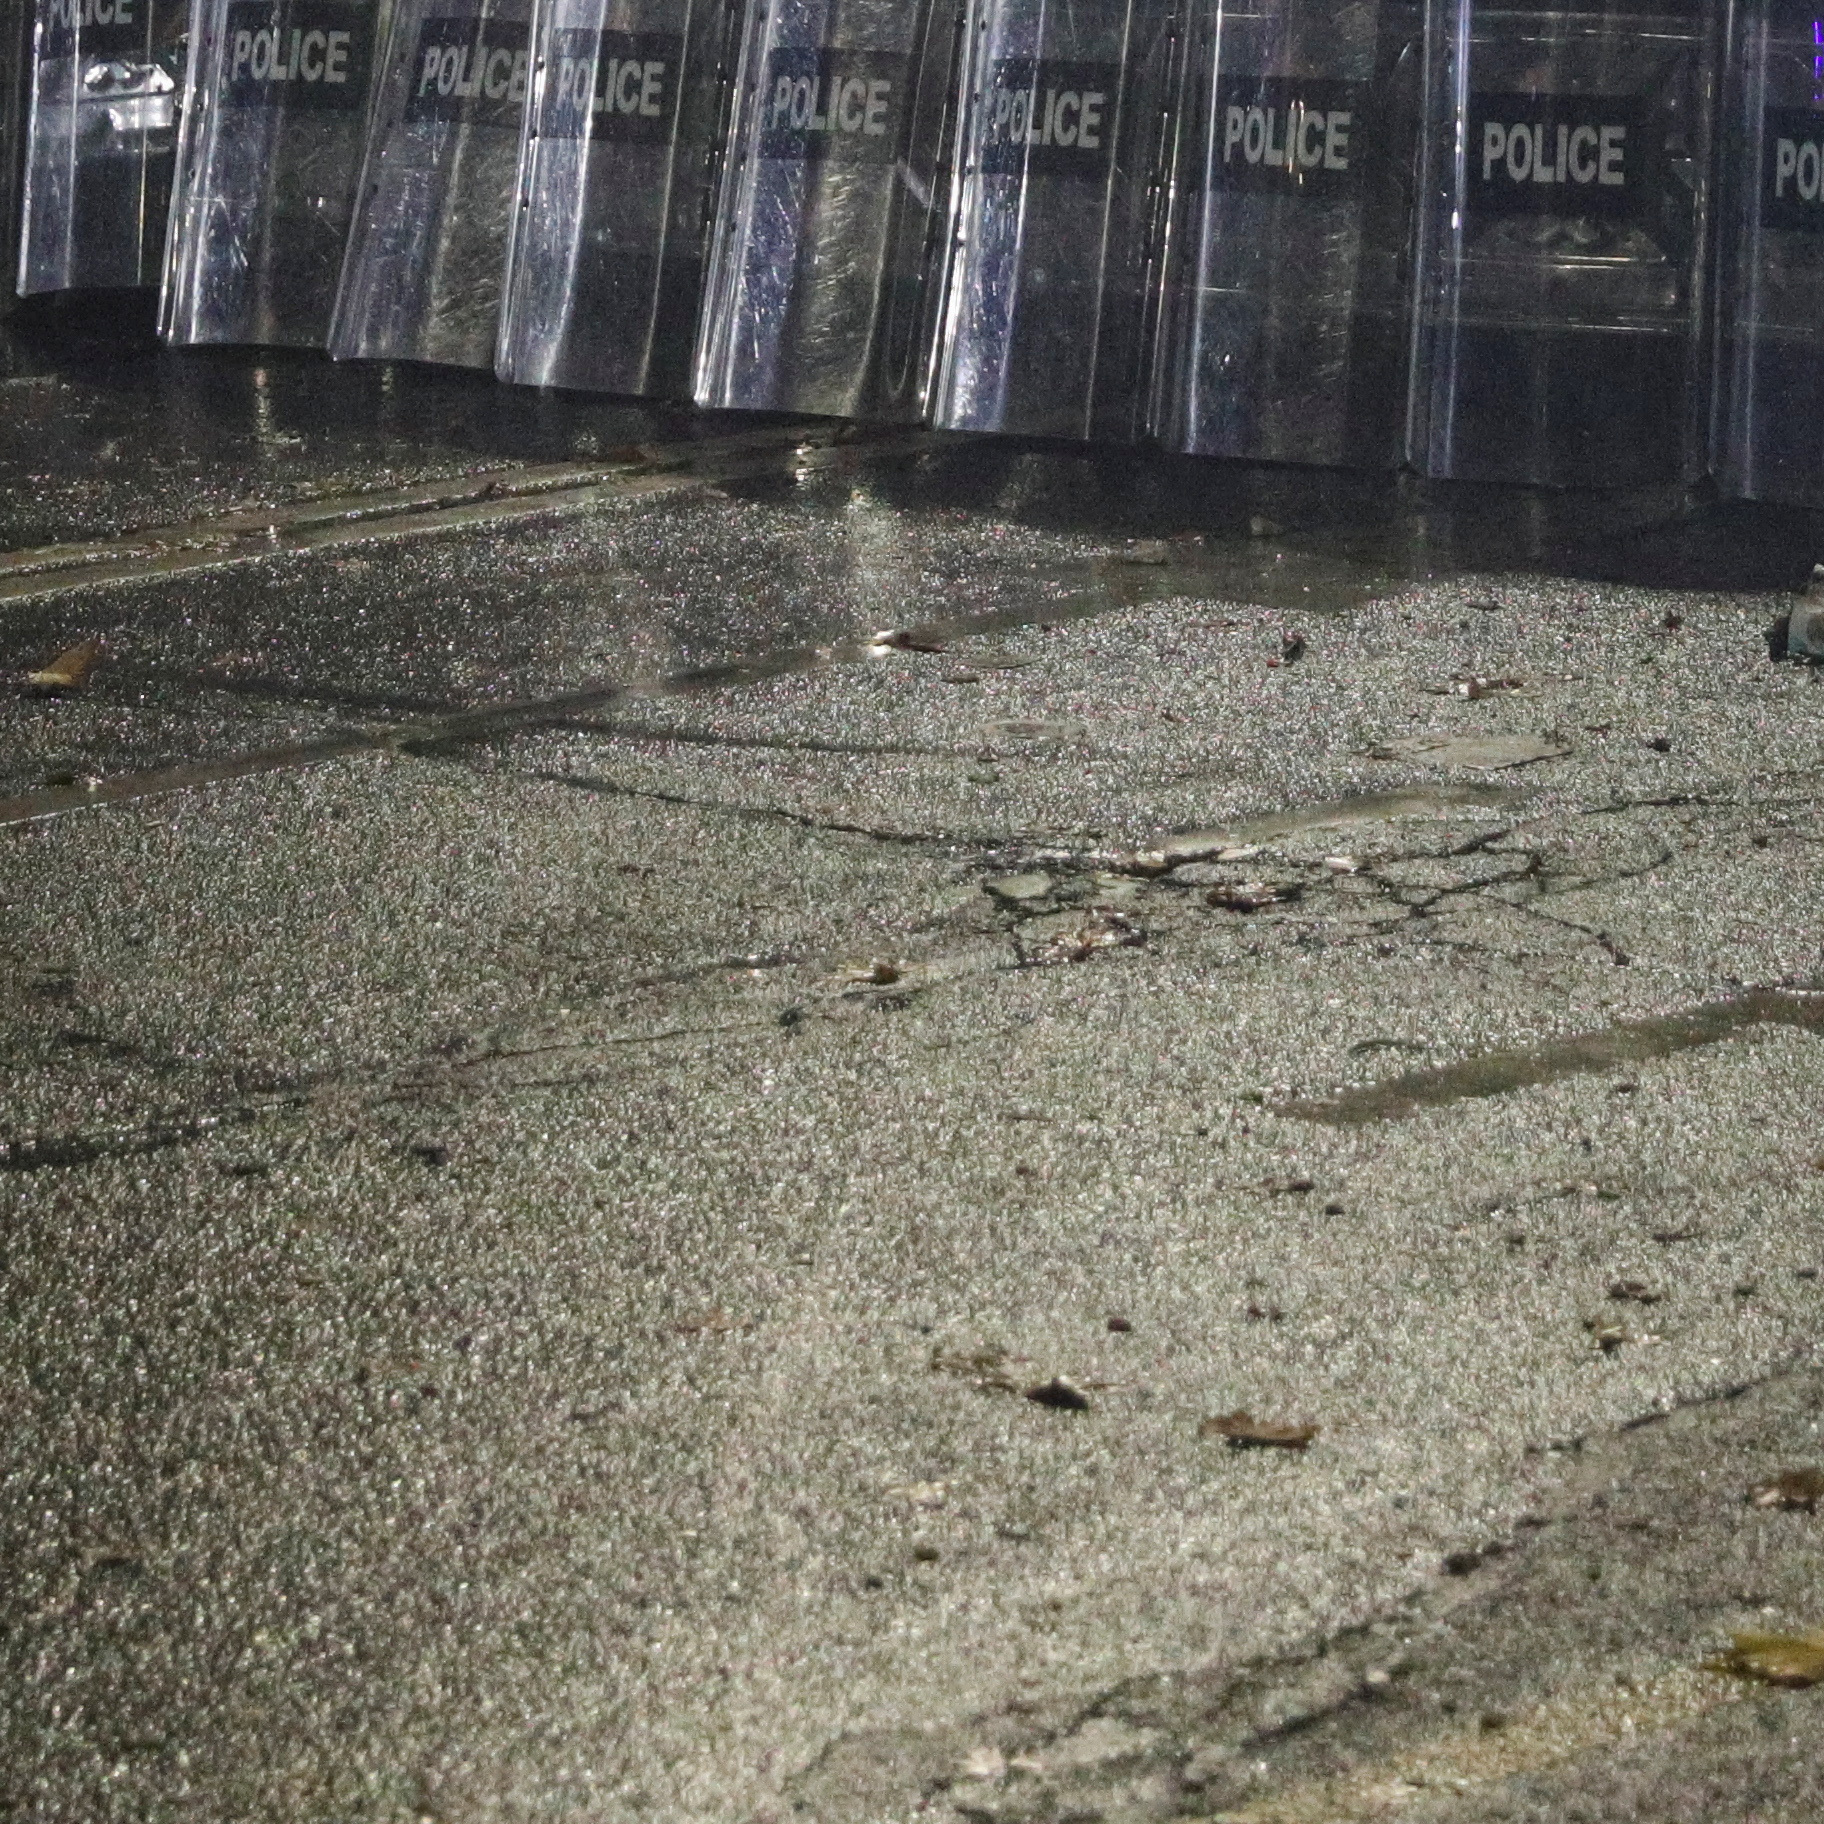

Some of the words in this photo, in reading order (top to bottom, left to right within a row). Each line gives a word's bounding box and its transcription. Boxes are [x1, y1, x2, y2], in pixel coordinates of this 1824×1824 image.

[231, 27, 350, 84] POLICE
[419, 44, 529, 102] POLICE
[556, 57, 665, 116] POLICE
[769, 74, 891, 136] POLICE
[992, 87, 1107, 150] POLICE
[1223, 104, 1353, 171] POLICE
[1481, 121, 1627, 186] POLICE
